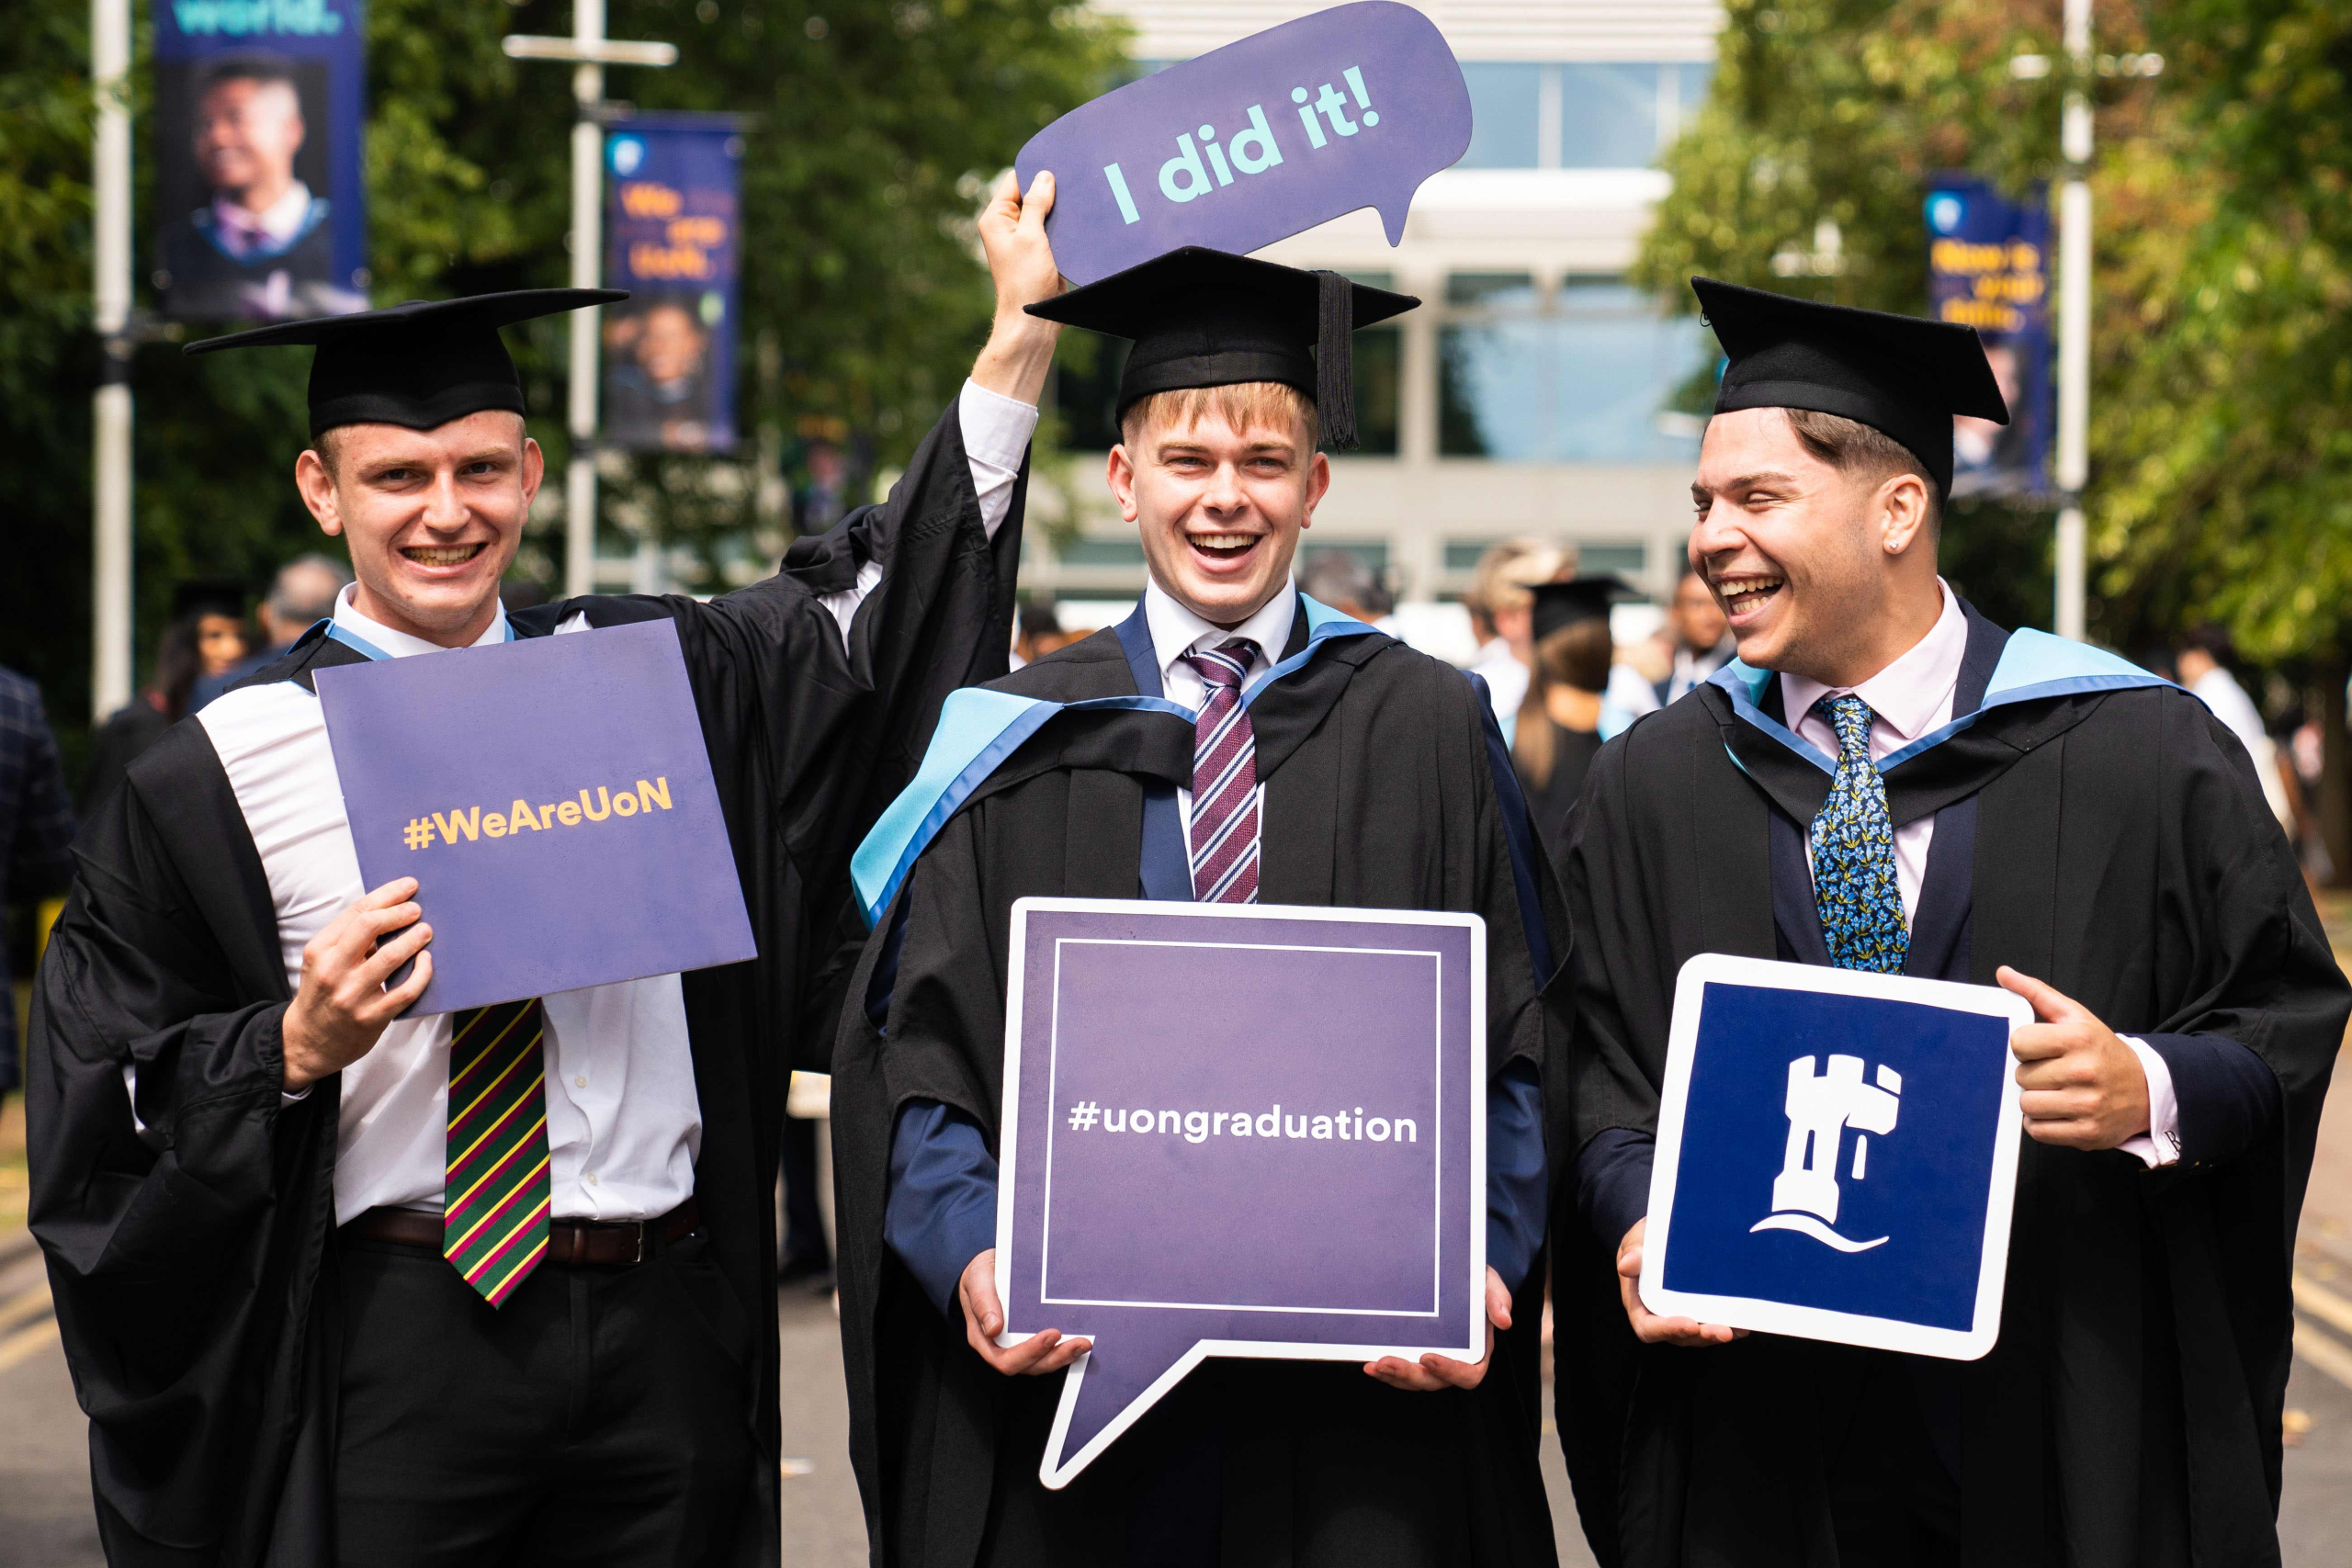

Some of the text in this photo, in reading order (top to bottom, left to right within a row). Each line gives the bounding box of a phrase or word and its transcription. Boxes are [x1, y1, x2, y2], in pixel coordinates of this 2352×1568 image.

[1103, 65, 1379, 225] I did it!
[403, 777, 673, 851] #WeAreUoN
[1068, 1100, 1417, 1144] #uongraduation
